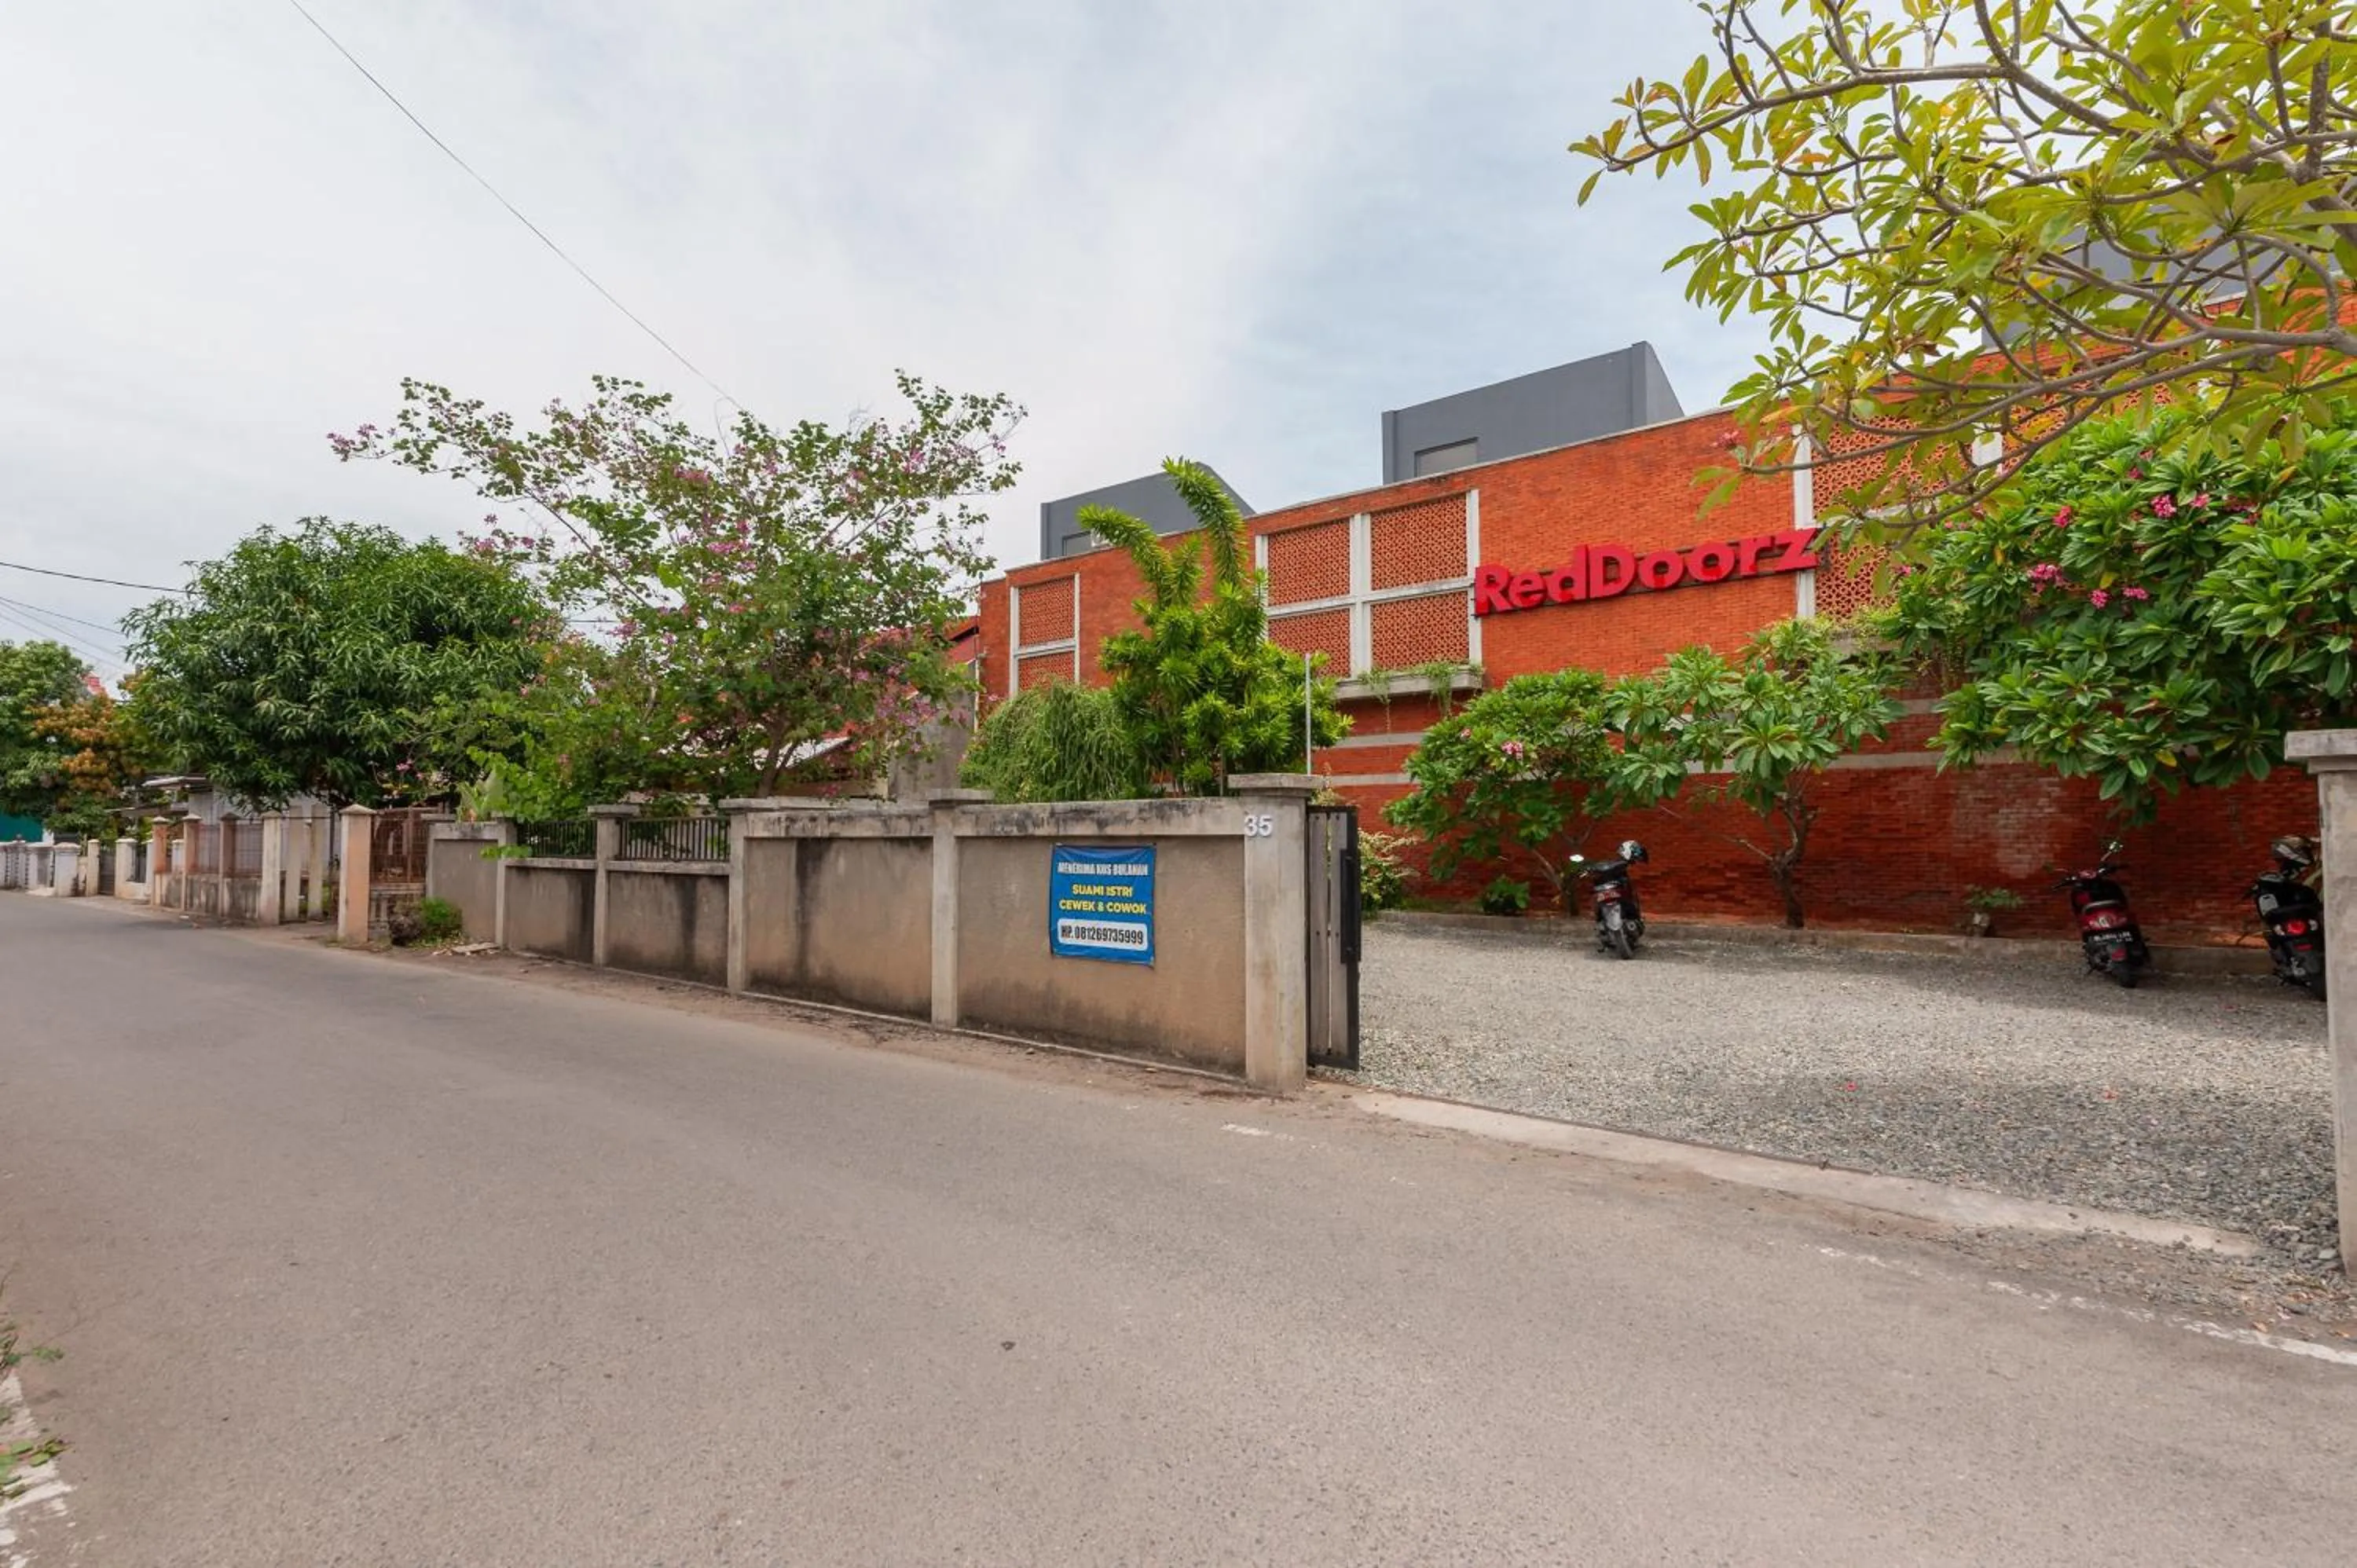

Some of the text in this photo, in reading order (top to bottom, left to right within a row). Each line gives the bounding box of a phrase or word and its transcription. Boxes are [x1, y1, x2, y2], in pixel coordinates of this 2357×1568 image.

[1475, 527, 1819, 616] RedDoorz
[1244, 815, 1272, 837] 35
[1072, 884, 1133, 897] SUAMI ISTRI
[1059, 899, 1095, 912] CEWEK
[1106, 901, 1146, 914] COWOK
